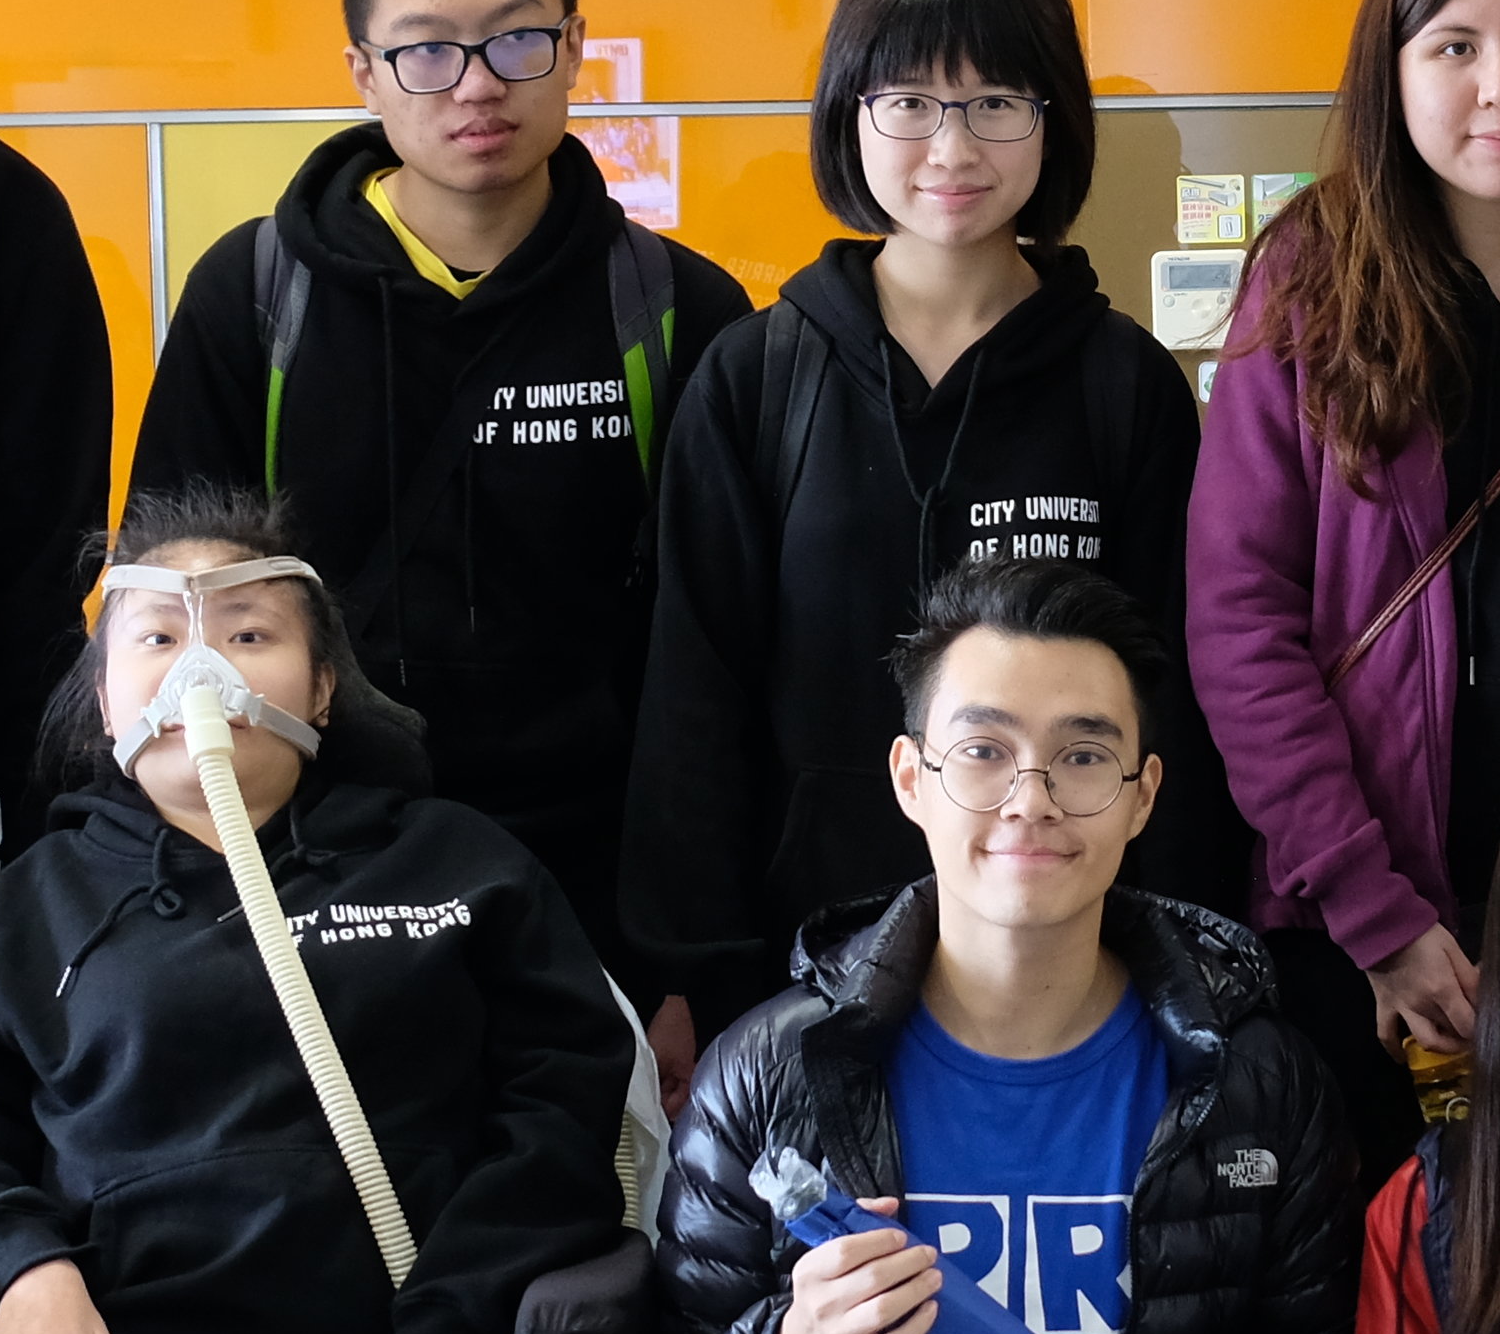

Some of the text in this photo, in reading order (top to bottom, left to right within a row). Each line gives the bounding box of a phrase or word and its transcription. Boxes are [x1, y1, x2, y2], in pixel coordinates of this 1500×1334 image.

[525, 378, 627, 410] UNIVERSI
[512, 417, 579, 445] HONG
[970, 498, 1016, 528] CITY
[969, 537, 999, 563] OF
[1012, 533, 1070, 561] HONG
[286, 898, 461, 934] ITY UNIVERSITY
[320, 922, 393, 945] HONG
[405, 904, 473, 940] KONG
[1217, 1161, 1261, 1176] NORTH
[1235, 1149, 1261, 1162] THE
[1229, 1173, 1261, 1188] FACE
